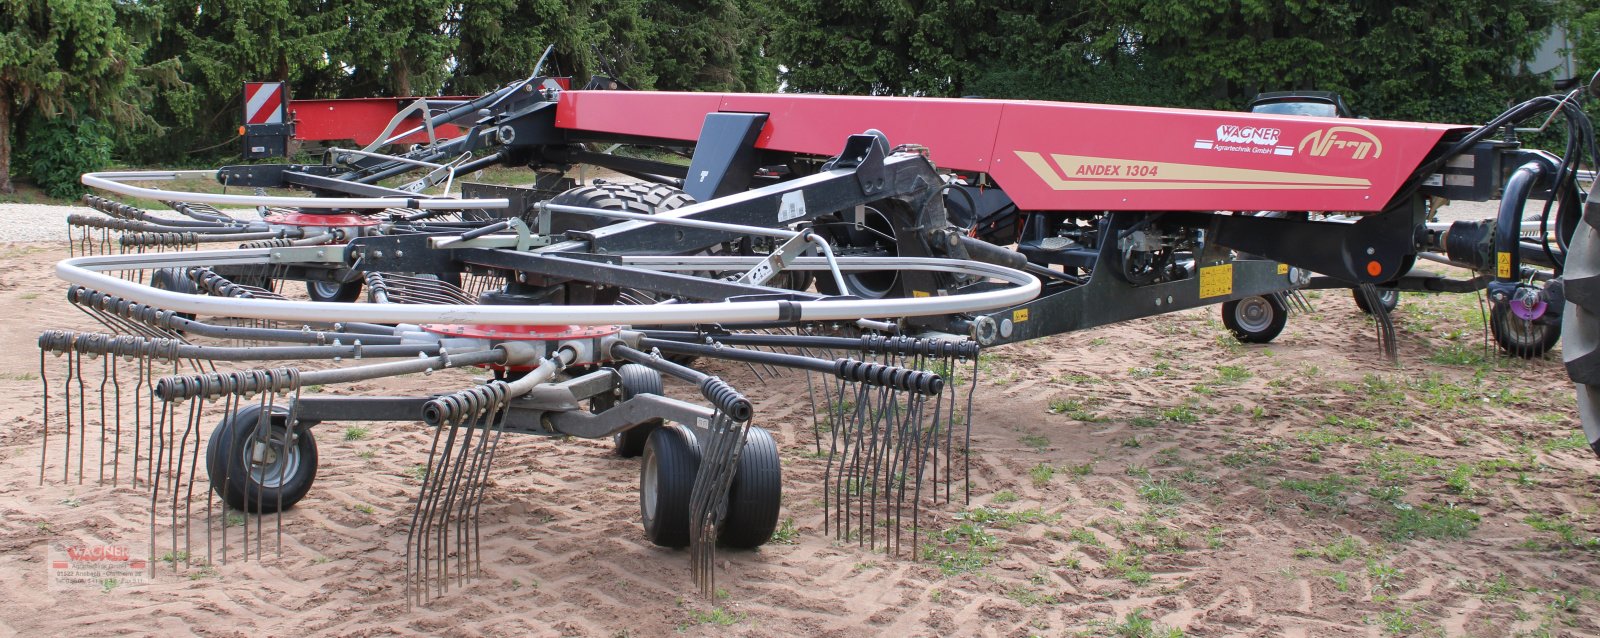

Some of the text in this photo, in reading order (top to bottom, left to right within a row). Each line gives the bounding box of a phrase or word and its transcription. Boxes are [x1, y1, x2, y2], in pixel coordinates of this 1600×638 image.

[1217, 125, 1280, 143] WAGNER
[1214, 145, 1251, 153] Agrartechnik
[1076, 164, 1158, 177] ANDEX 1304
